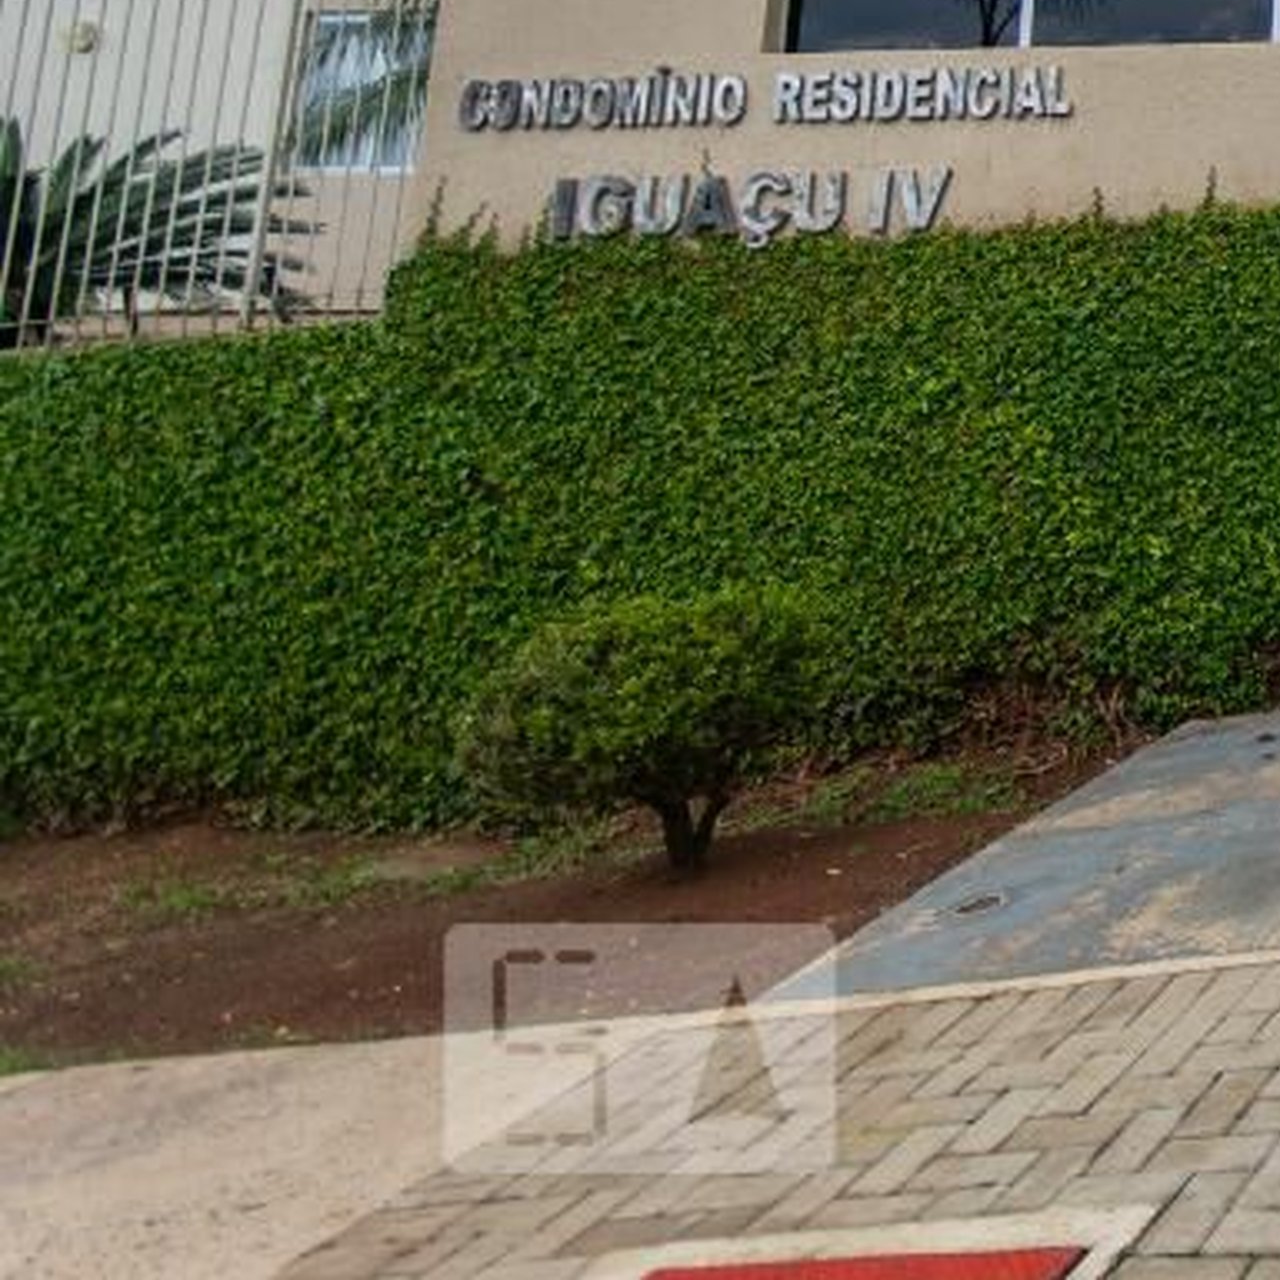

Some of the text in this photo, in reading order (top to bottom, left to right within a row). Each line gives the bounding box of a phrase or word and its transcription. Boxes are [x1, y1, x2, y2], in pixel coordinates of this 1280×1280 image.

[461, 65, 1075, 131] CONDOMÍNIO RESIDENCIAL
[552, 161, 954, 249] IGUAÇU IV
